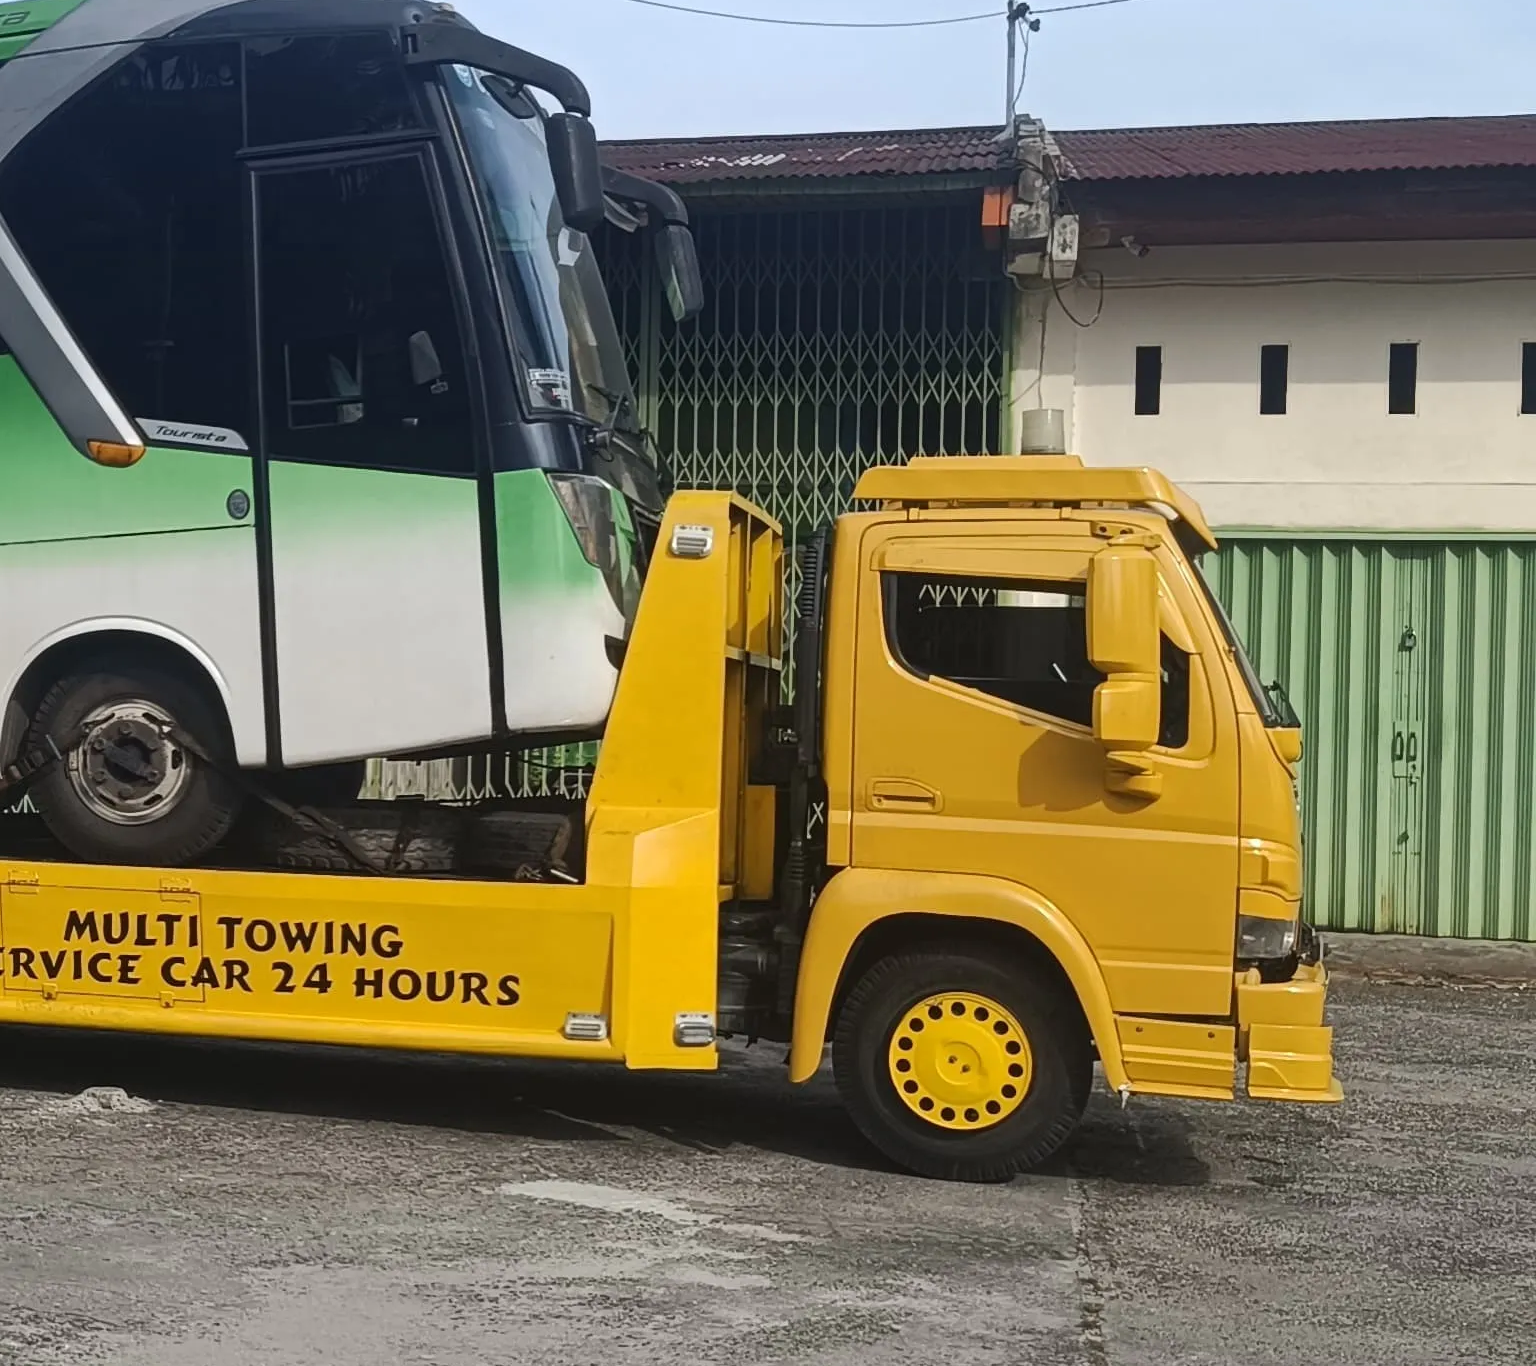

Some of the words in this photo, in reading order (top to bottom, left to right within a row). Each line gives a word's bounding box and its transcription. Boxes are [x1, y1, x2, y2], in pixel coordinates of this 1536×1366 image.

[155, 425, 227, 443] Tourista
[64, 910, 199, 948] MULTI
[217, 915, 404, 958] TOWING
[160, 956, 252, 991] CAR
[270, 961, 333, 994] 24
[353, 966, 521, 1007] HOURS
